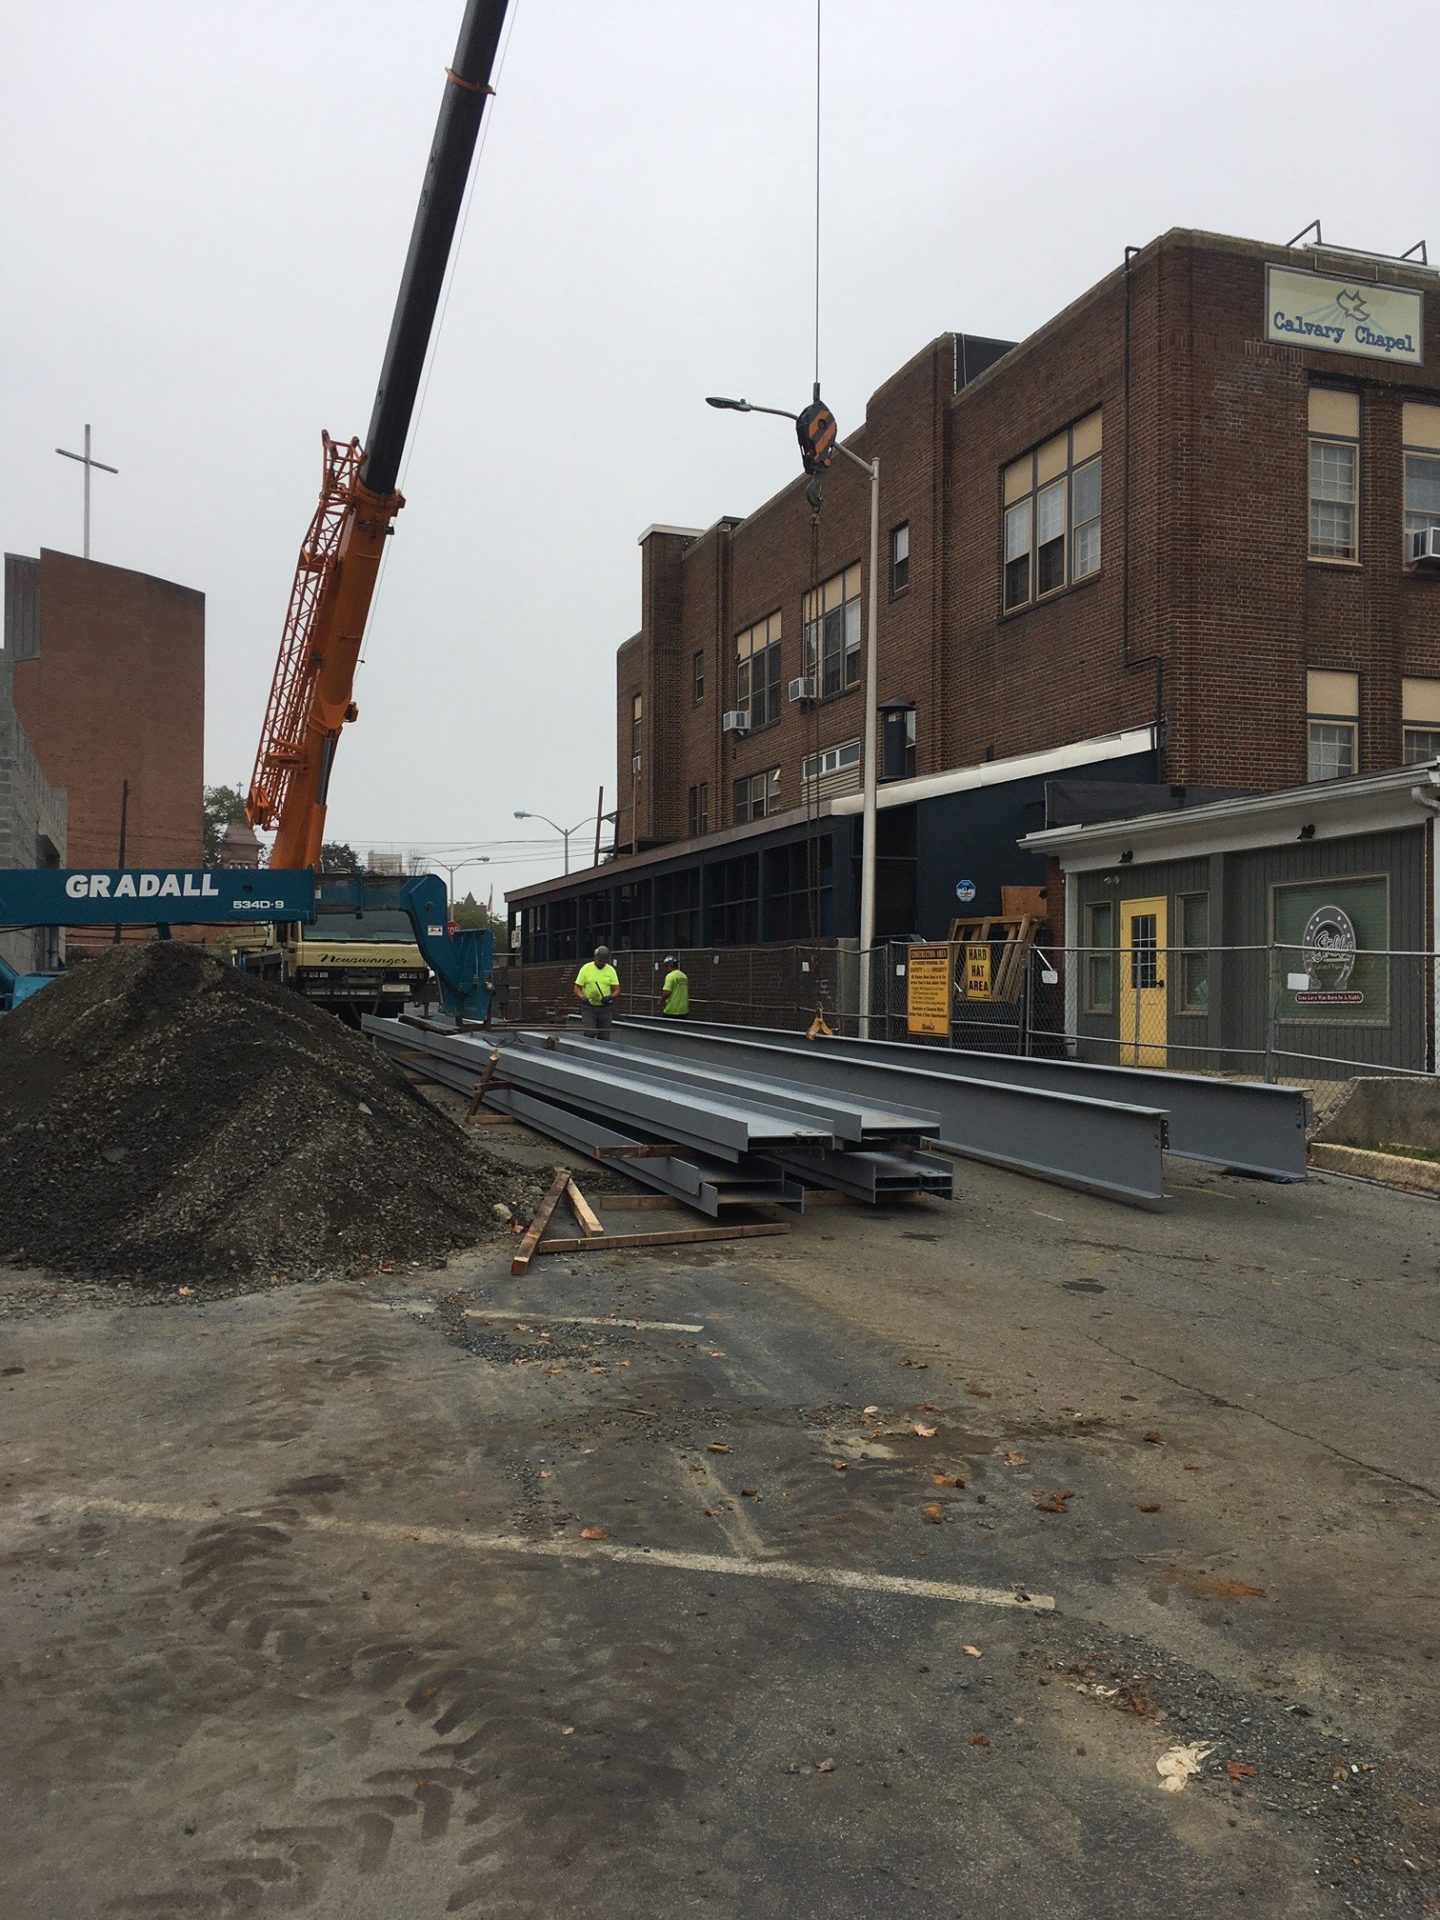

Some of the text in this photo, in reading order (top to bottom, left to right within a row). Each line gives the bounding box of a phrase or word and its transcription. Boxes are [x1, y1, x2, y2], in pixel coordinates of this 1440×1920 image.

[1274, 312, 1416, 352] Calvary Chapel
[65, 874, 219, 898] GRADALL
[968, 948, 987, 961] HARD
[971, 964, 985, 978] HAT
[968, 980, 989, 992] AREA
